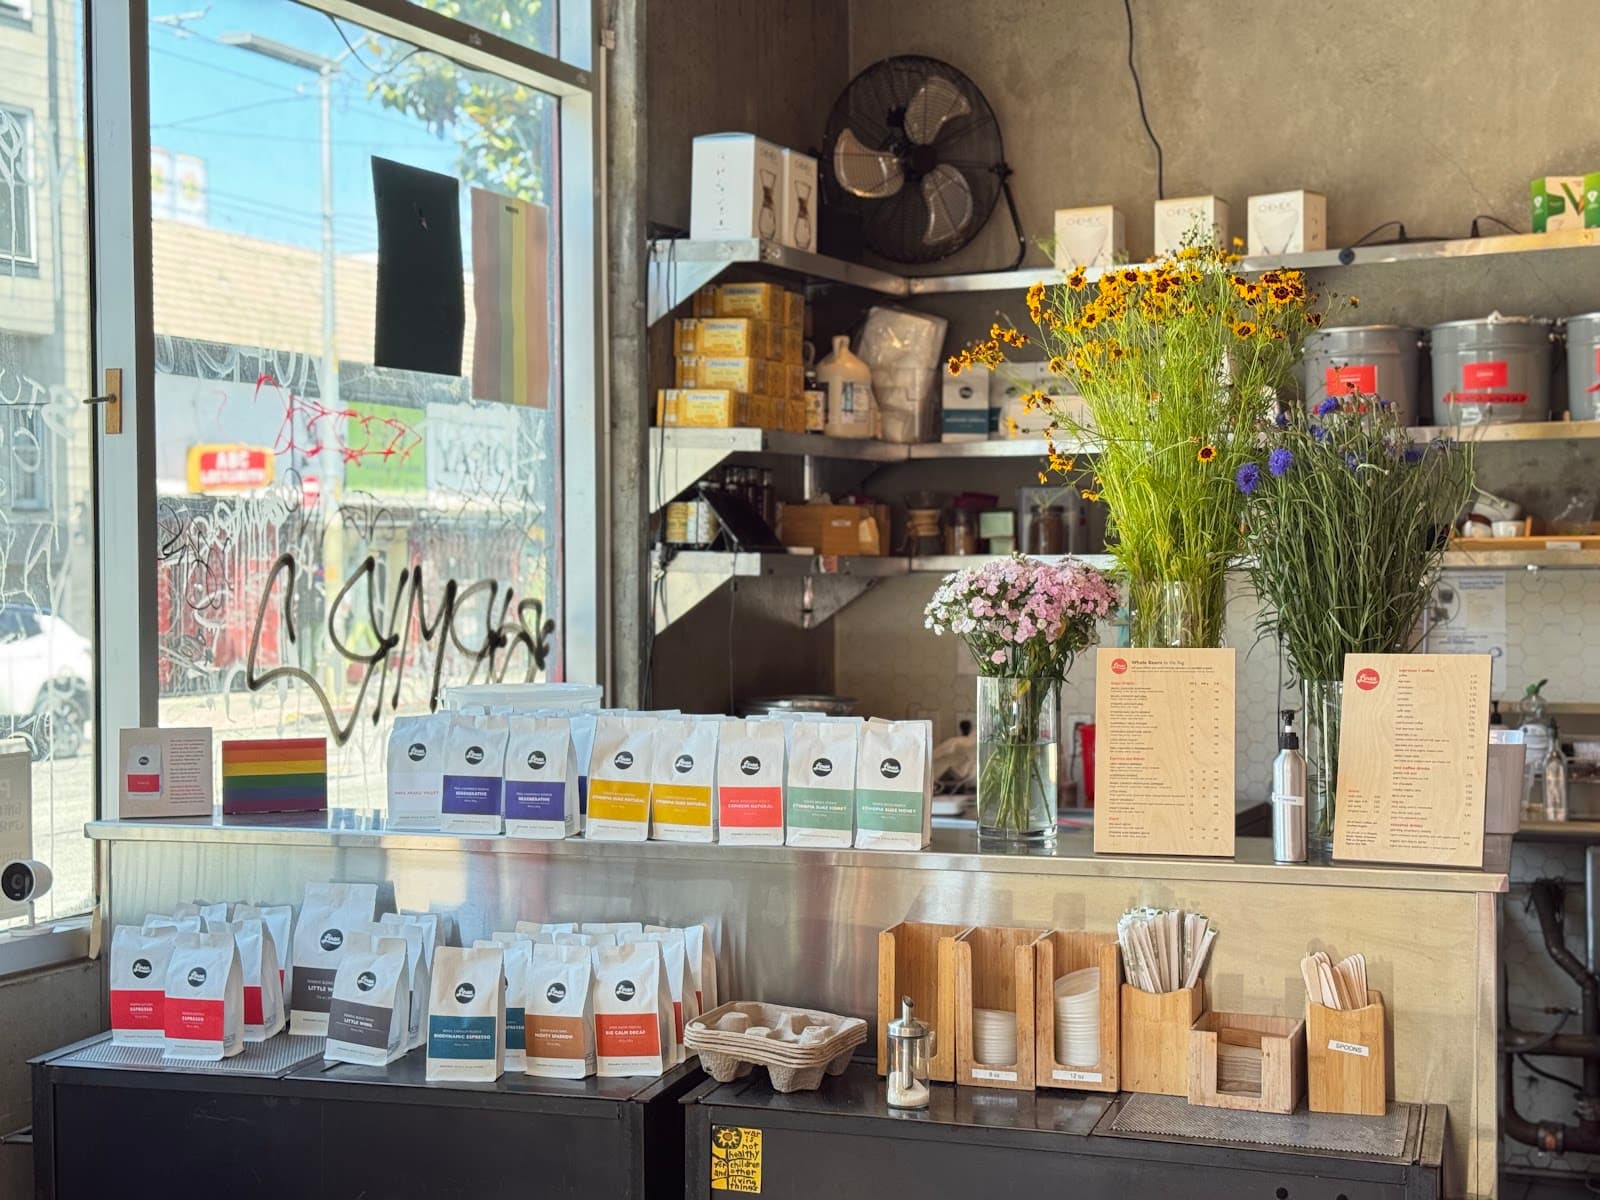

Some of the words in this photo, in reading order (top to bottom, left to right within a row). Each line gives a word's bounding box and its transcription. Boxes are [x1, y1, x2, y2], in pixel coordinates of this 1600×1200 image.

[1336, 1042, 1362, 1053] SPOONS
[729, 1150, 760, 1160] healthy
[730, 1160, 760, 1168] children
[731, 1176, 757, 1186] living
